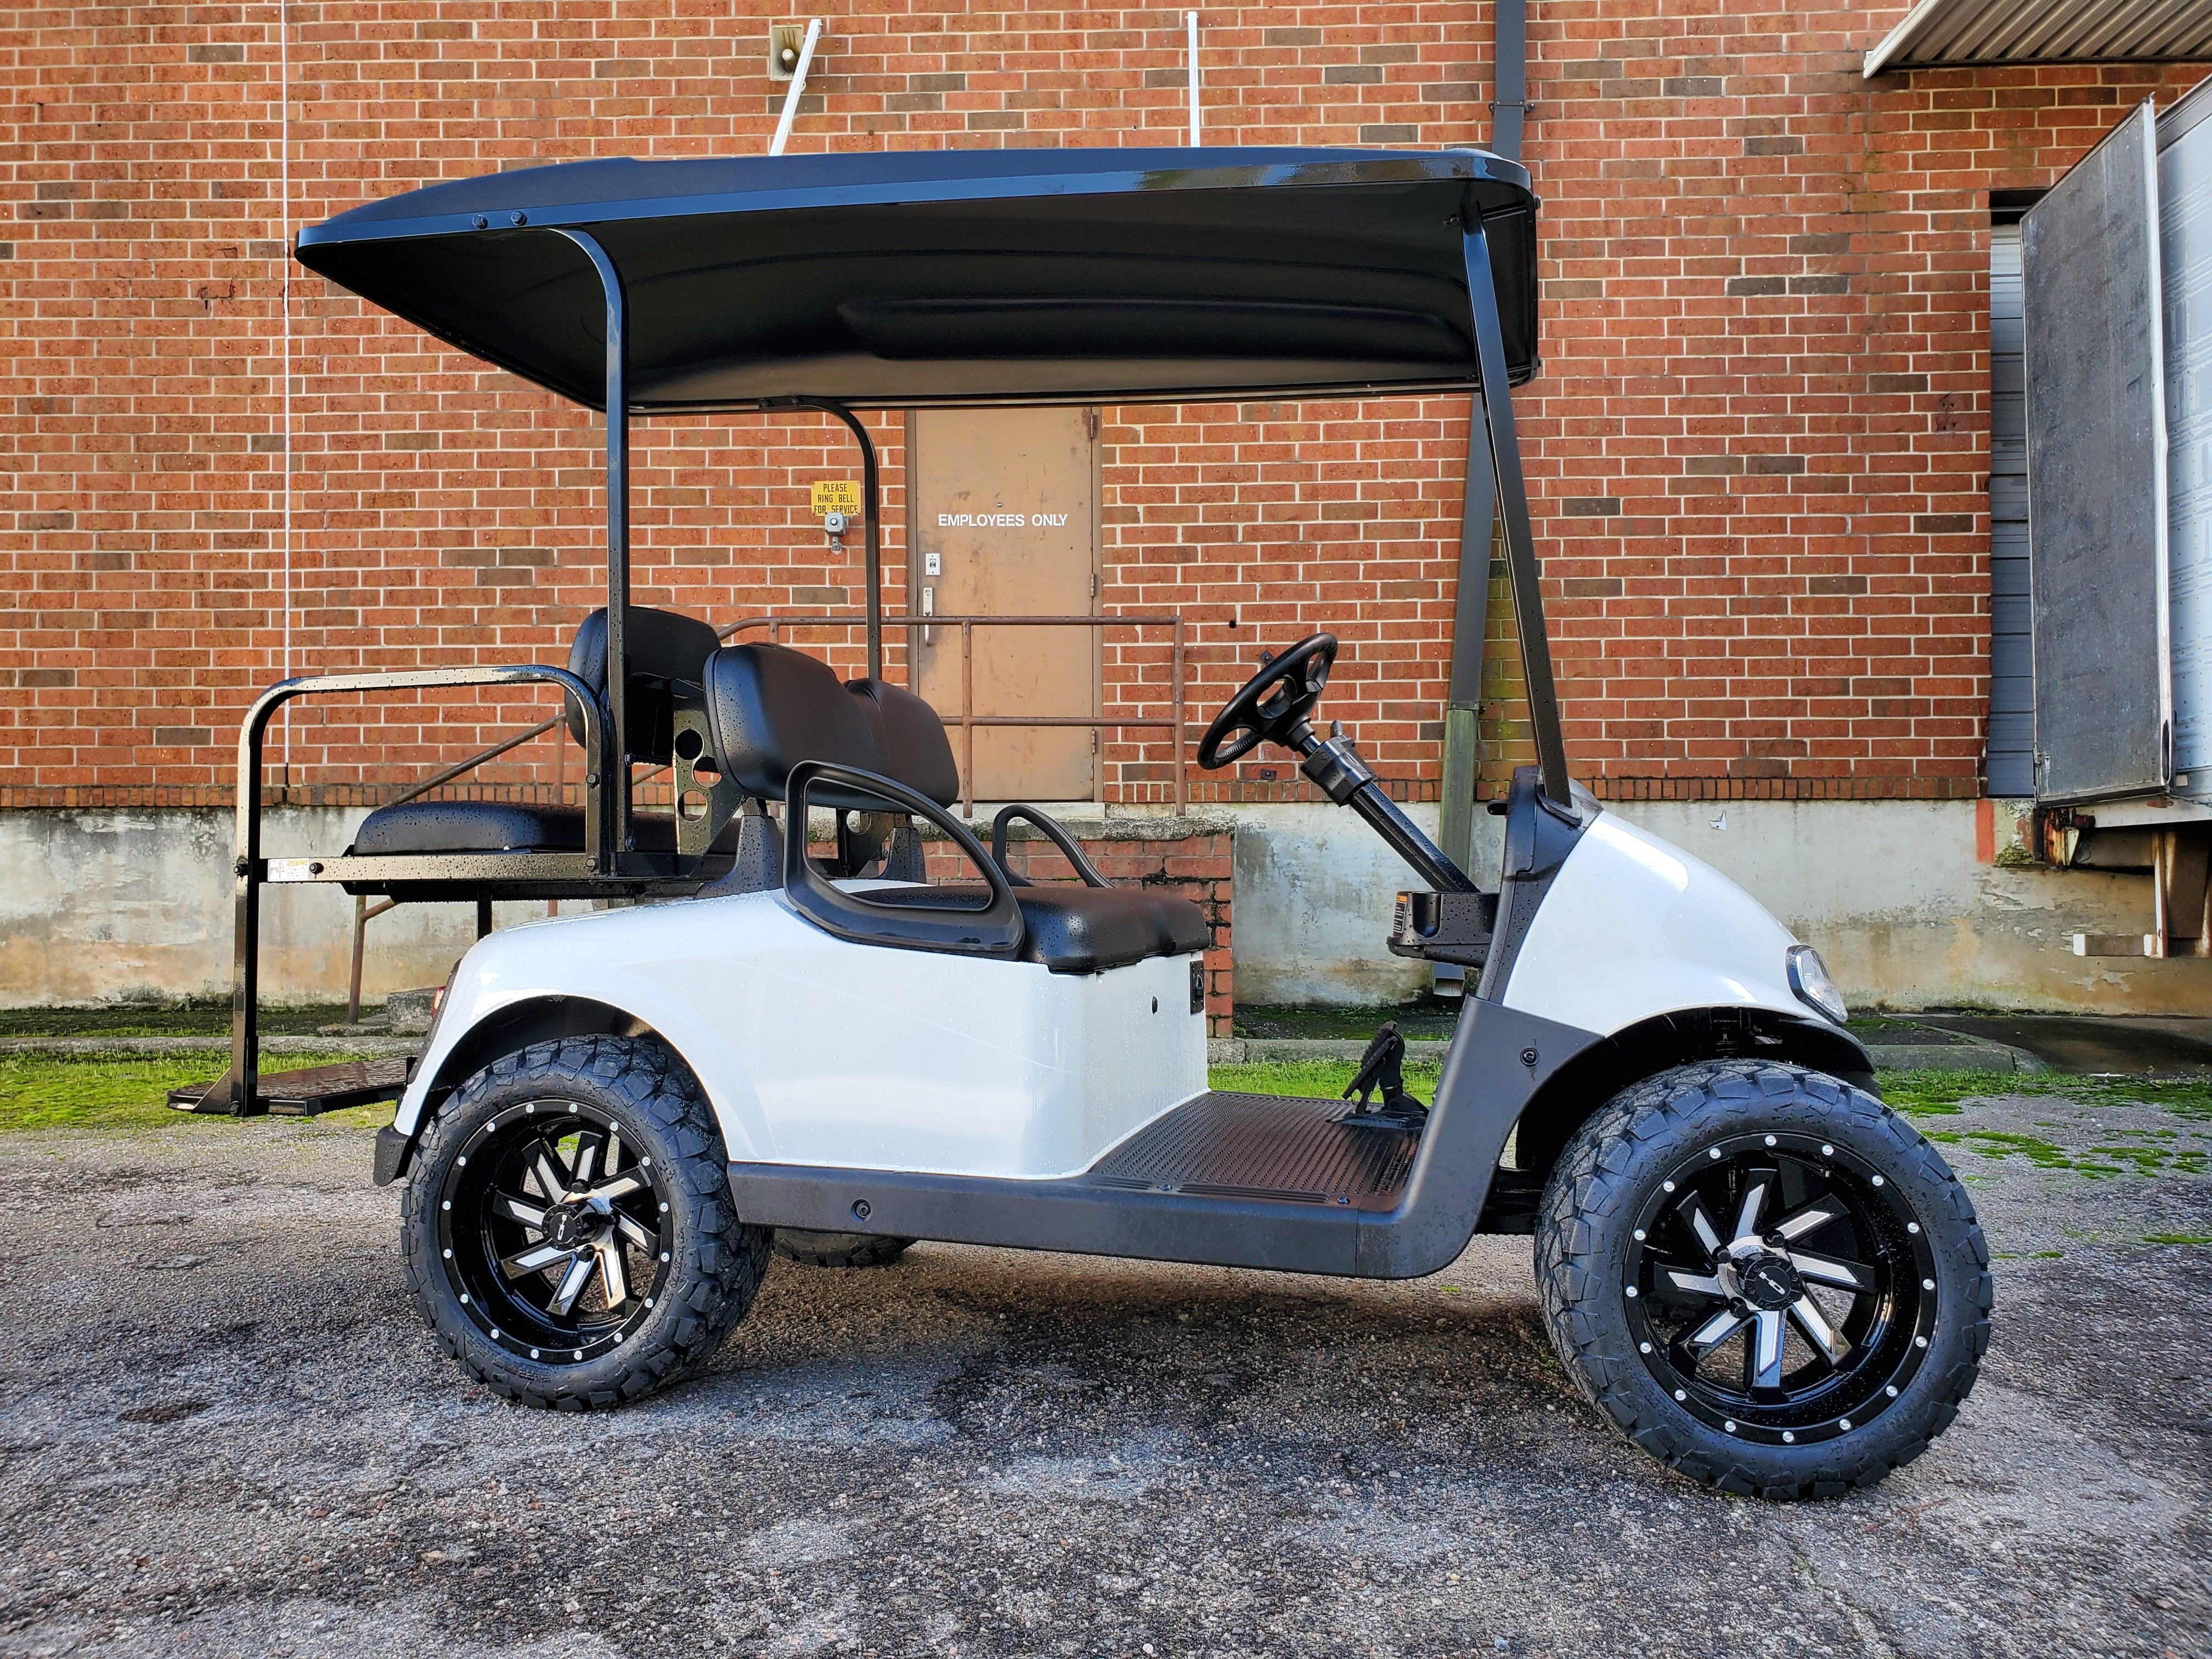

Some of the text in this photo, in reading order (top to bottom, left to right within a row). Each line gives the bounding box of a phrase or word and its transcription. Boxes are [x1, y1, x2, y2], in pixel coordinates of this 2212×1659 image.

[823, 483, 848, 492] PLEASE
[818, 494, 854, 503] RING BELL
[814, 505, 858, 514] FOR SERVICE
[938, 514, 1068, 527] EMPLOYEES ONLY
